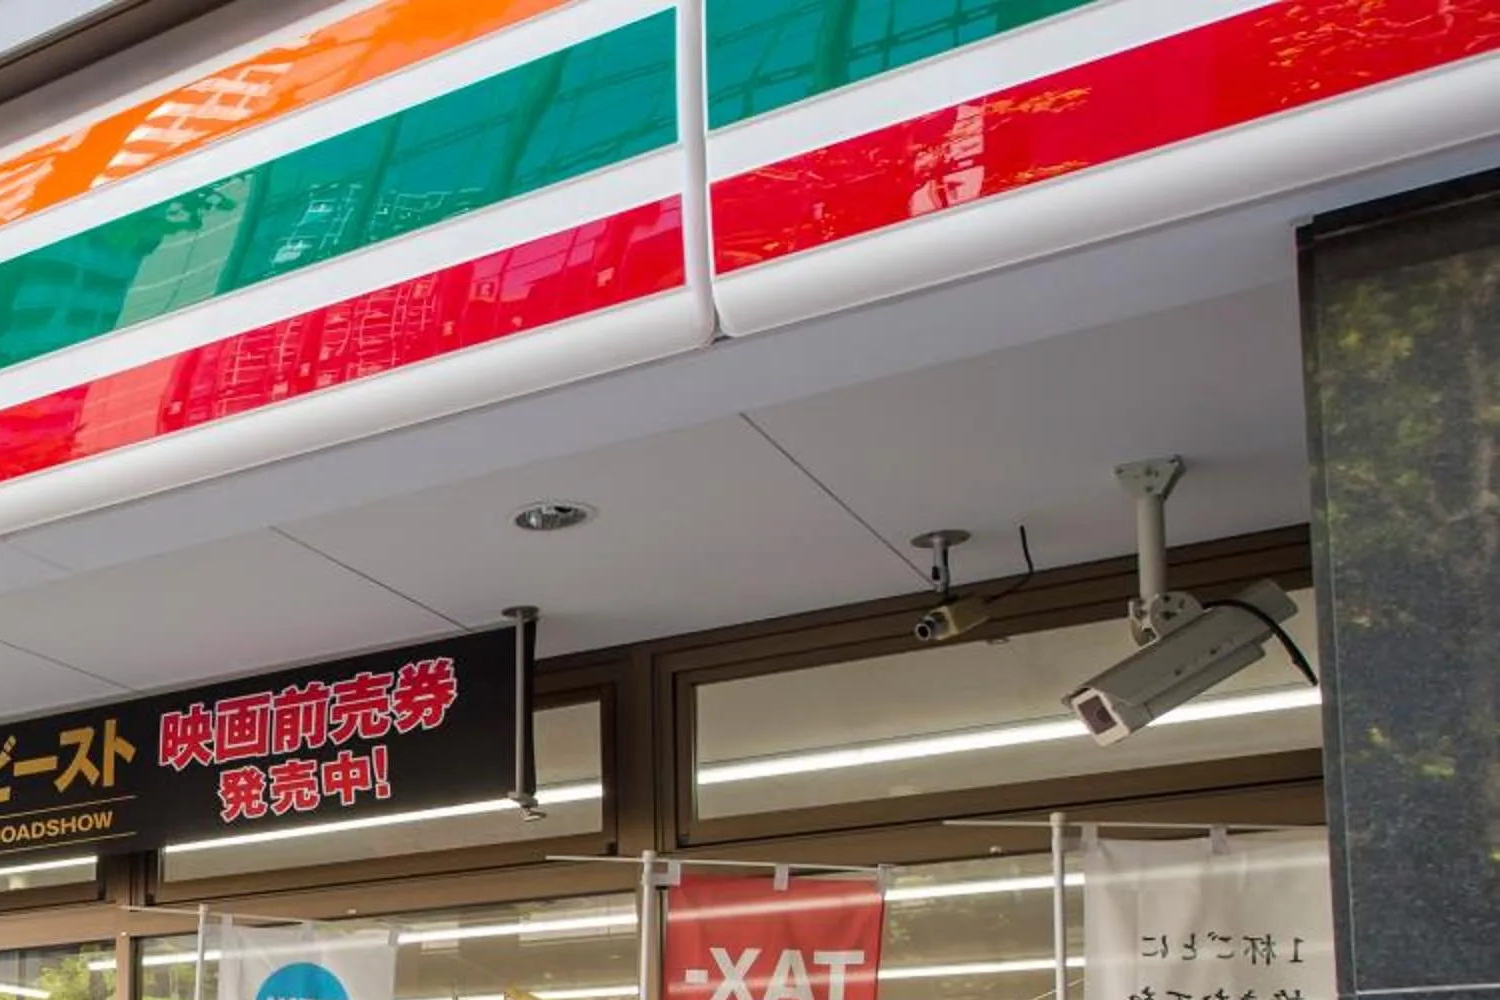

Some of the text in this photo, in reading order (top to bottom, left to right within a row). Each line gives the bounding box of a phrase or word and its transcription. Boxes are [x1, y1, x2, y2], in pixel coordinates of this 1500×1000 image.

[159, 657, 457, 771] 映画前売券
[219, 745, 390, 822] 発売中!
